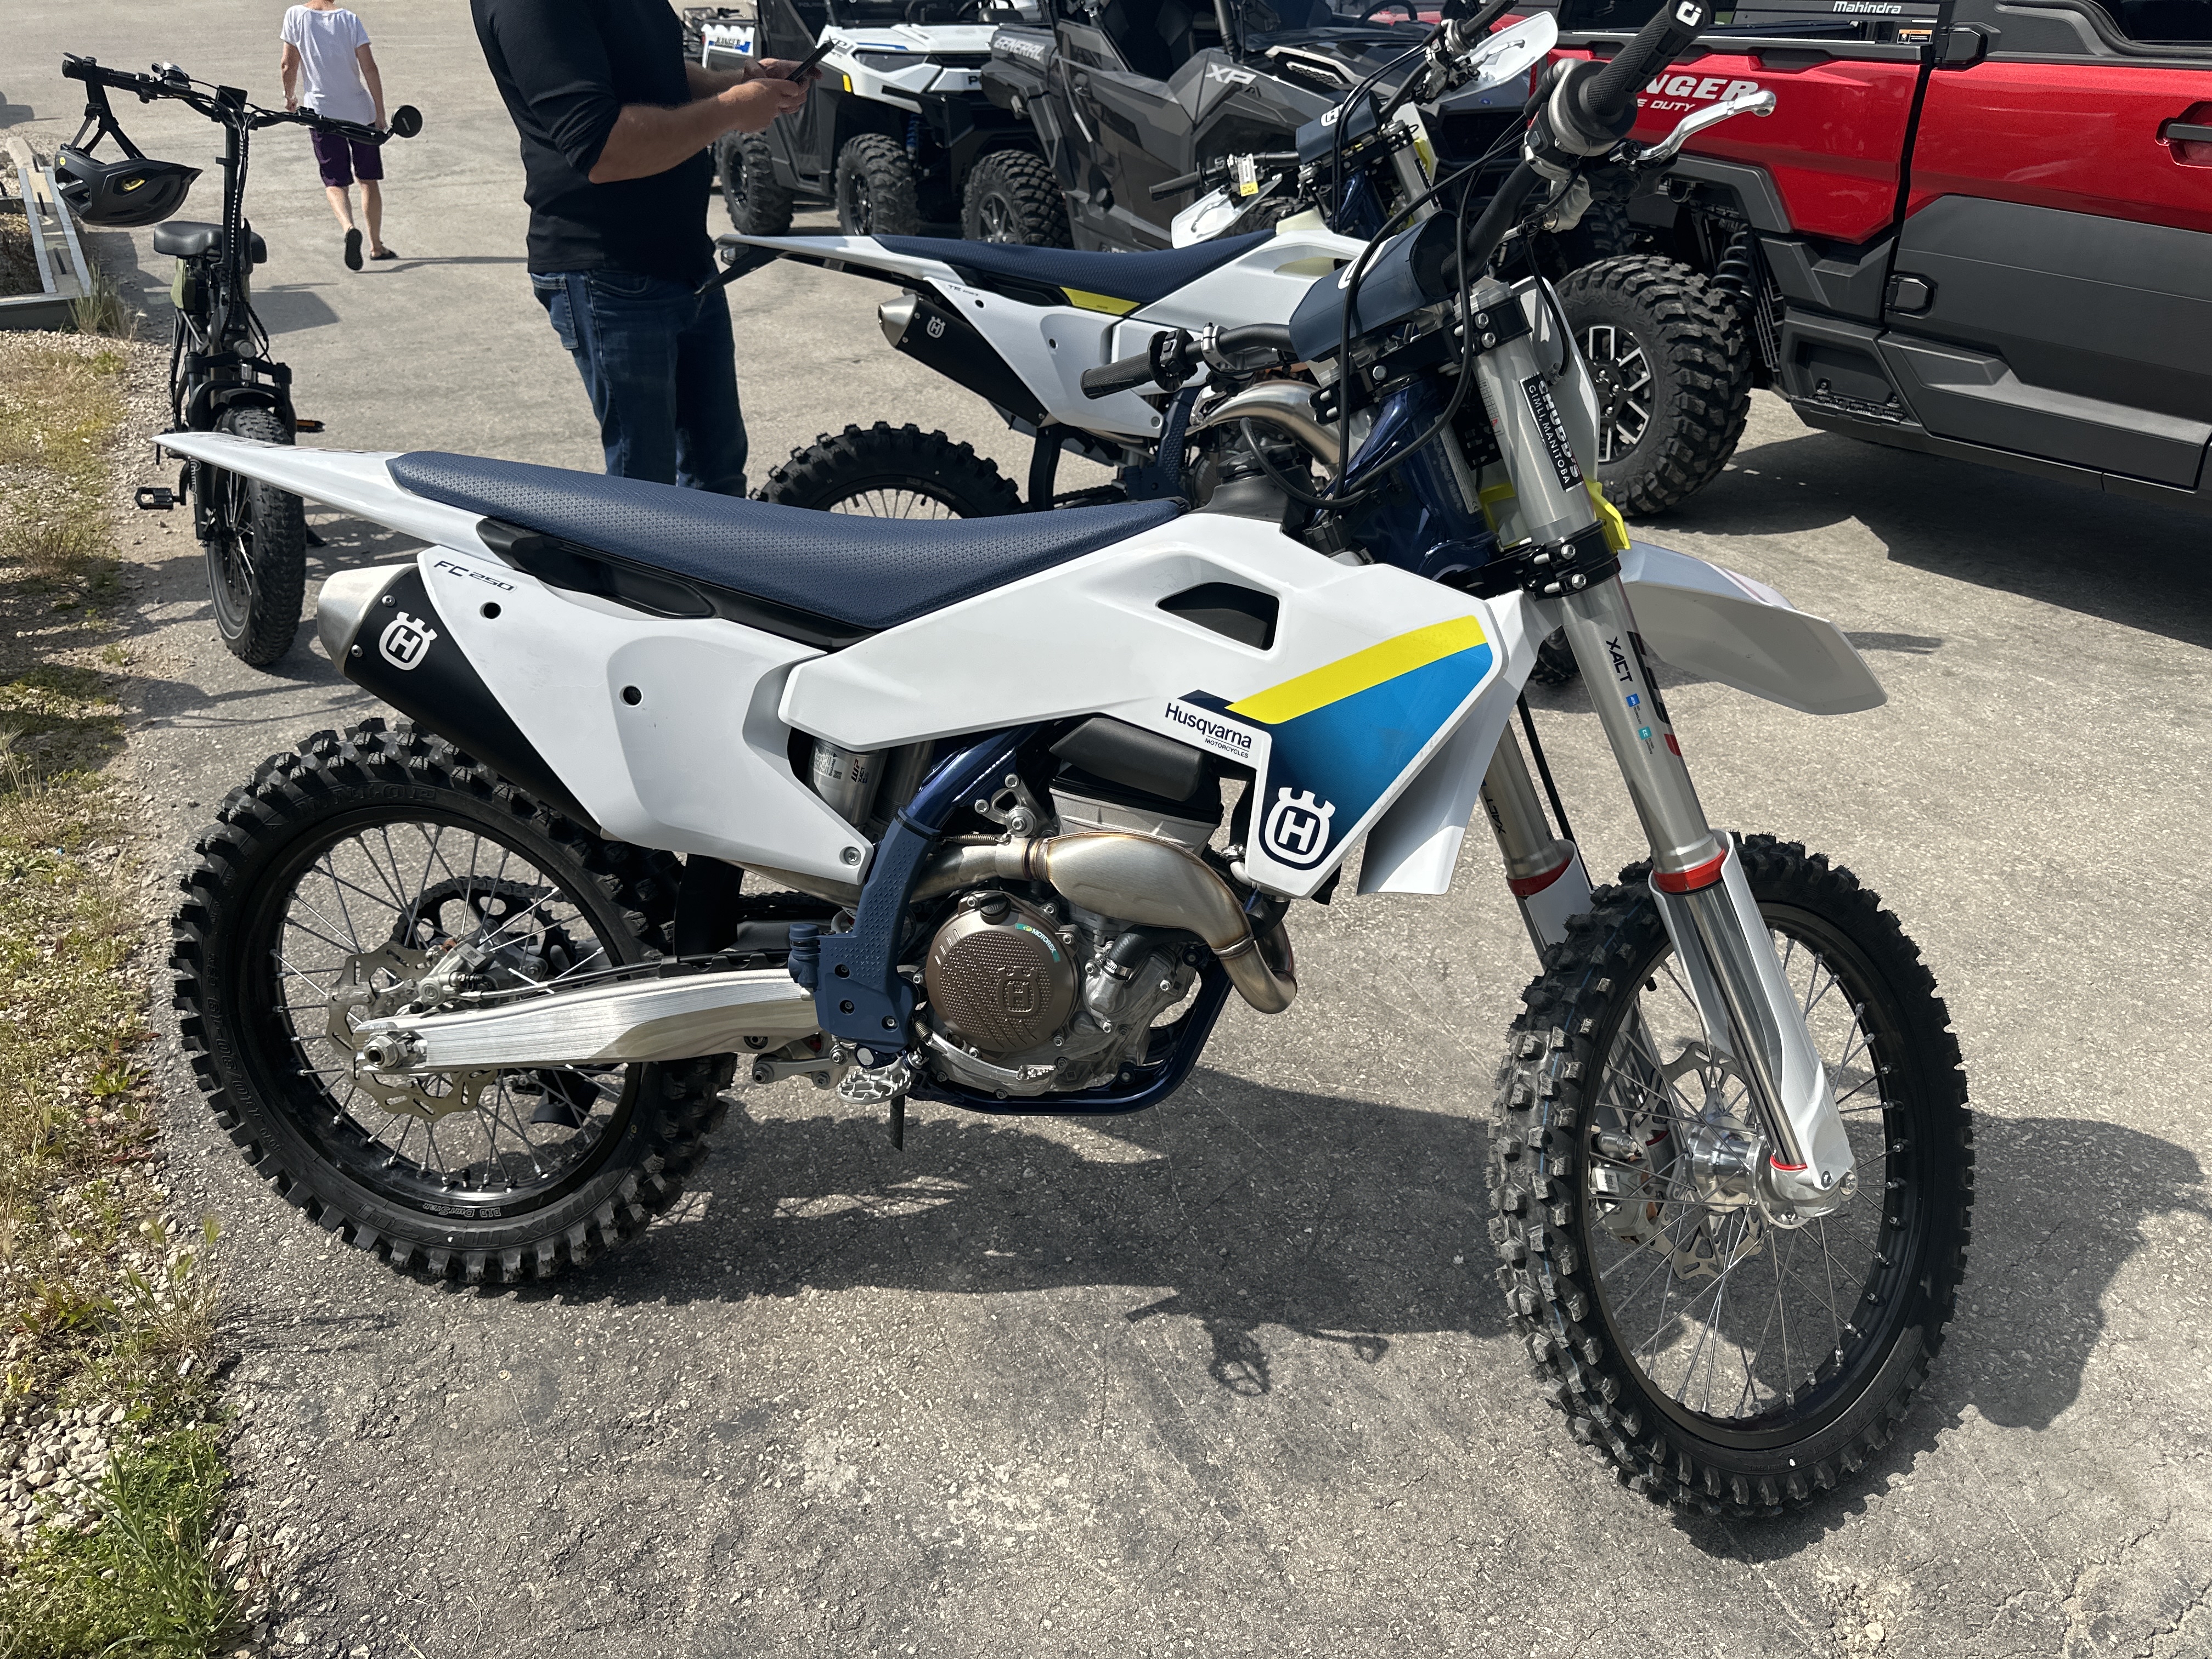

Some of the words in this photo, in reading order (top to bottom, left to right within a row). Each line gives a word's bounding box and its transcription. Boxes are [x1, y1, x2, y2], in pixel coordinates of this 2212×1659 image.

[1833, 1, 1901, 14] Mahindra
[994, 36, 1045, 61] GENERAL
[1206, 63, 1257, 85] XP
[1646, 74, 1759, 101] NGER
[1650, 100, 1696, 112] DUTY
[1542, 421, 1570, 484] MANITOBA
[434, 561, 469, 578] FC
[468, 572, 515, 591] 250
[1605, 636, 1634, 682] XACT
[1165, 702, 1251, 749] Husqvarna
[1205, 738, 1249, 759] MOTORCYCLES
[1485, 796, 1506, 835] XACT
[1031, 928, 1057, 953] MOTOREX
